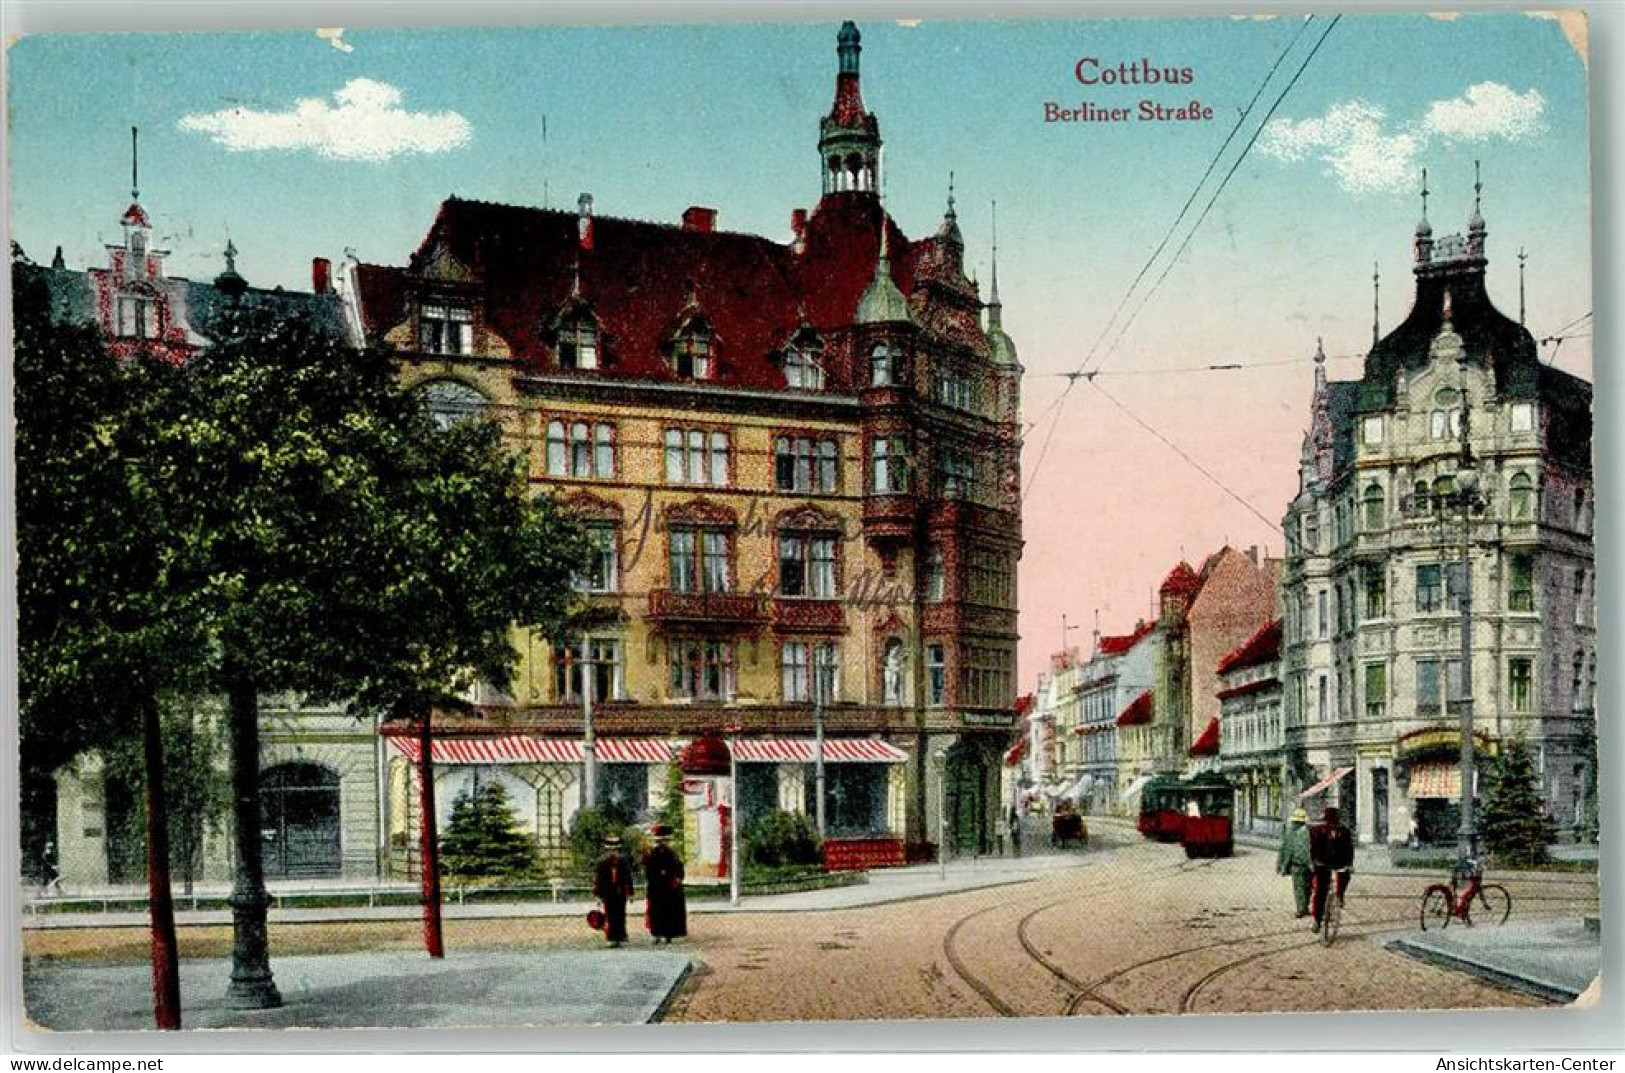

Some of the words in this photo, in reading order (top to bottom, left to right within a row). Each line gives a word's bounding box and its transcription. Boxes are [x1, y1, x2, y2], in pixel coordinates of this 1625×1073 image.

[1075, 57, 1194, 85] Cottbus
[1043, 102, 1131, 123] Berliner
[1138, 100, 1214, 121] Straße
